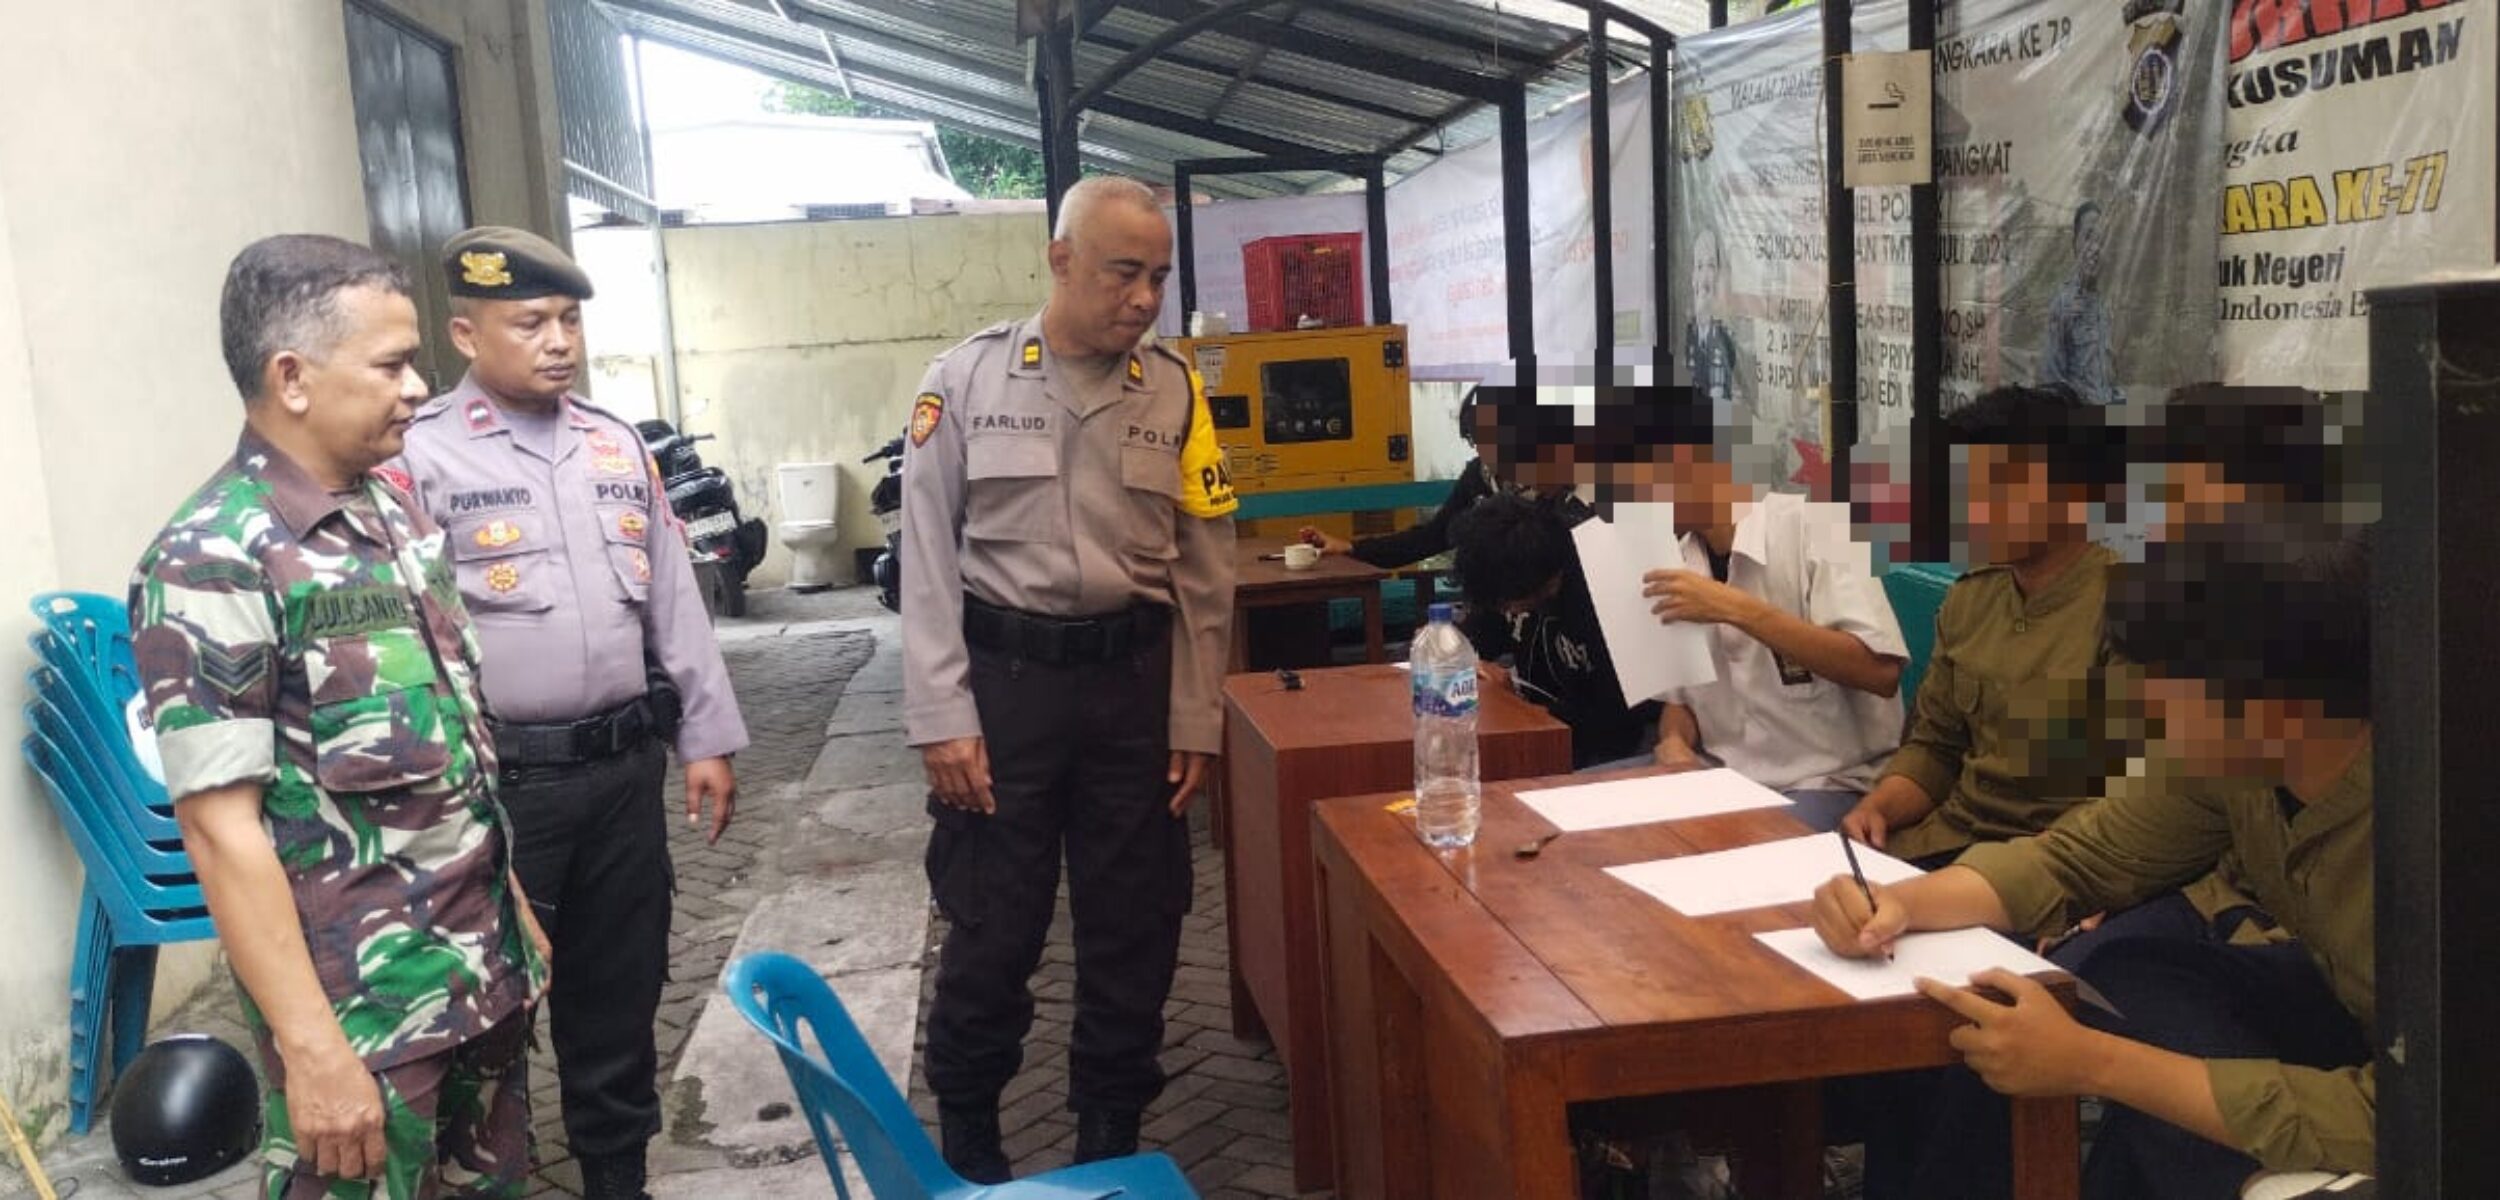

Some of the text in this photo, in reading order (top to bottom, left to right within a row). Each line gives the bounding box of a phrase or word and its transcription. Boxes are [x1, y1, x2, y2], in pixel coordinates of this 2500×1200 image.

[2019, 24, 2042, 60] KE
[2227, 17, 2465, 109] KUSUMAN
[1936, 140, 2012, 177] PANGKAT
[2220, 150, 2449, 235] ARA KE-77
[2219, 246, 2346, 288] uk Negeri
[2220, 290, 2342, 322] Indonesia
[973, 415, 1045, 431] FARLUD
